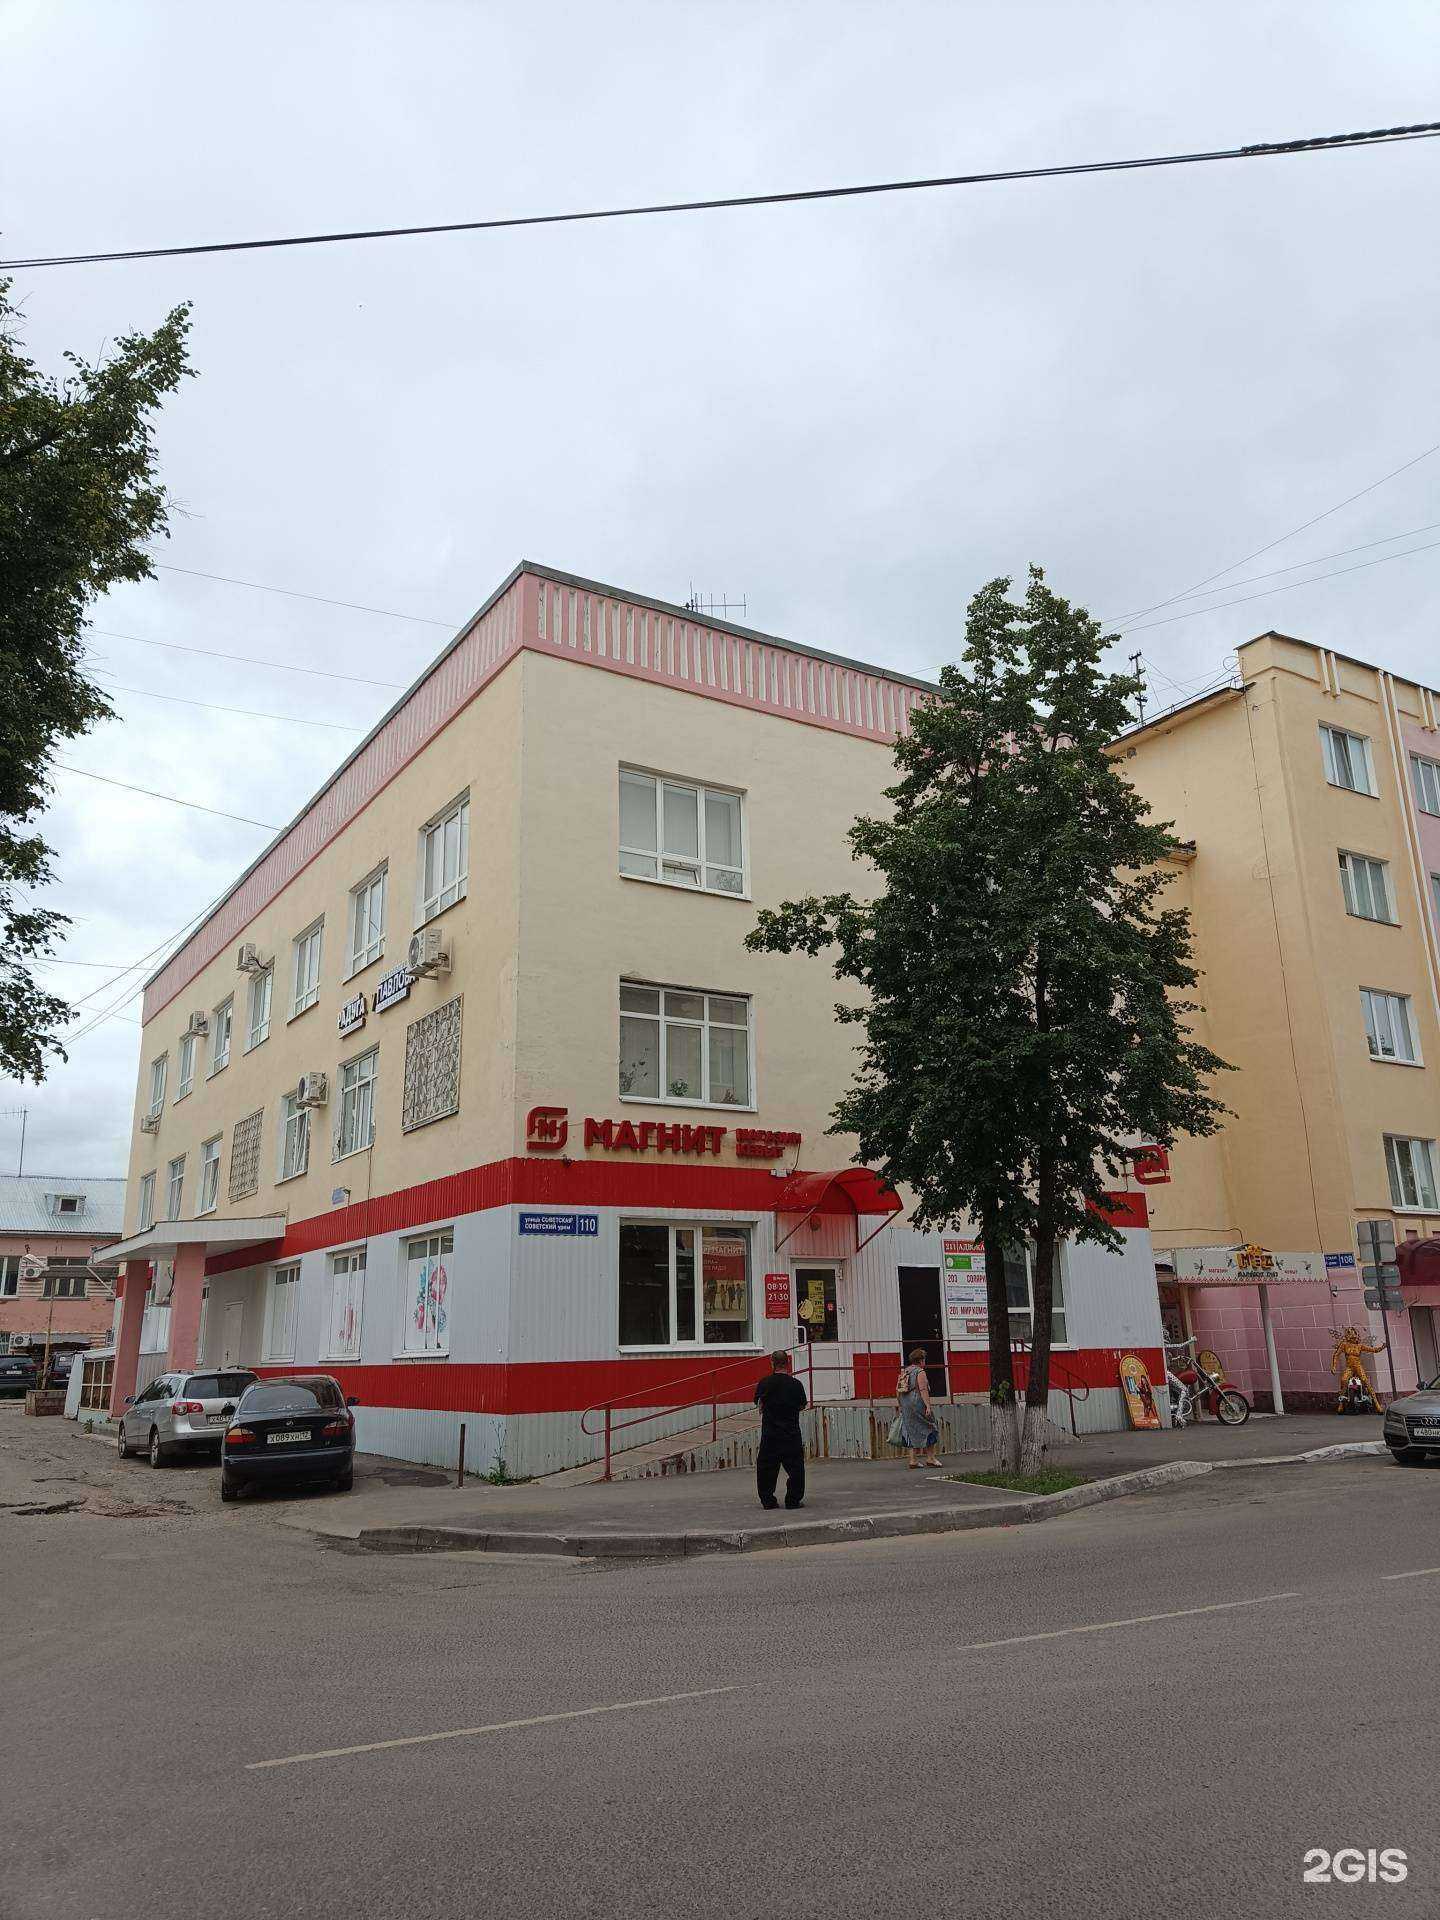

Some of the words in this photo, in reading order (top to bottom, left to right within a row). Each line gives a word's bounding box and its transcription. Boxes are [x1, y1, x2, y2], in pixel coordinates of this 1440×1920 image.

[584, 1117, 728, 1156] МАГНИТ
[580, 1218, 596, 1232] 110
[1340, 1255, 1353, 1265] 108
[947, 1274, 958, 1283] 203
